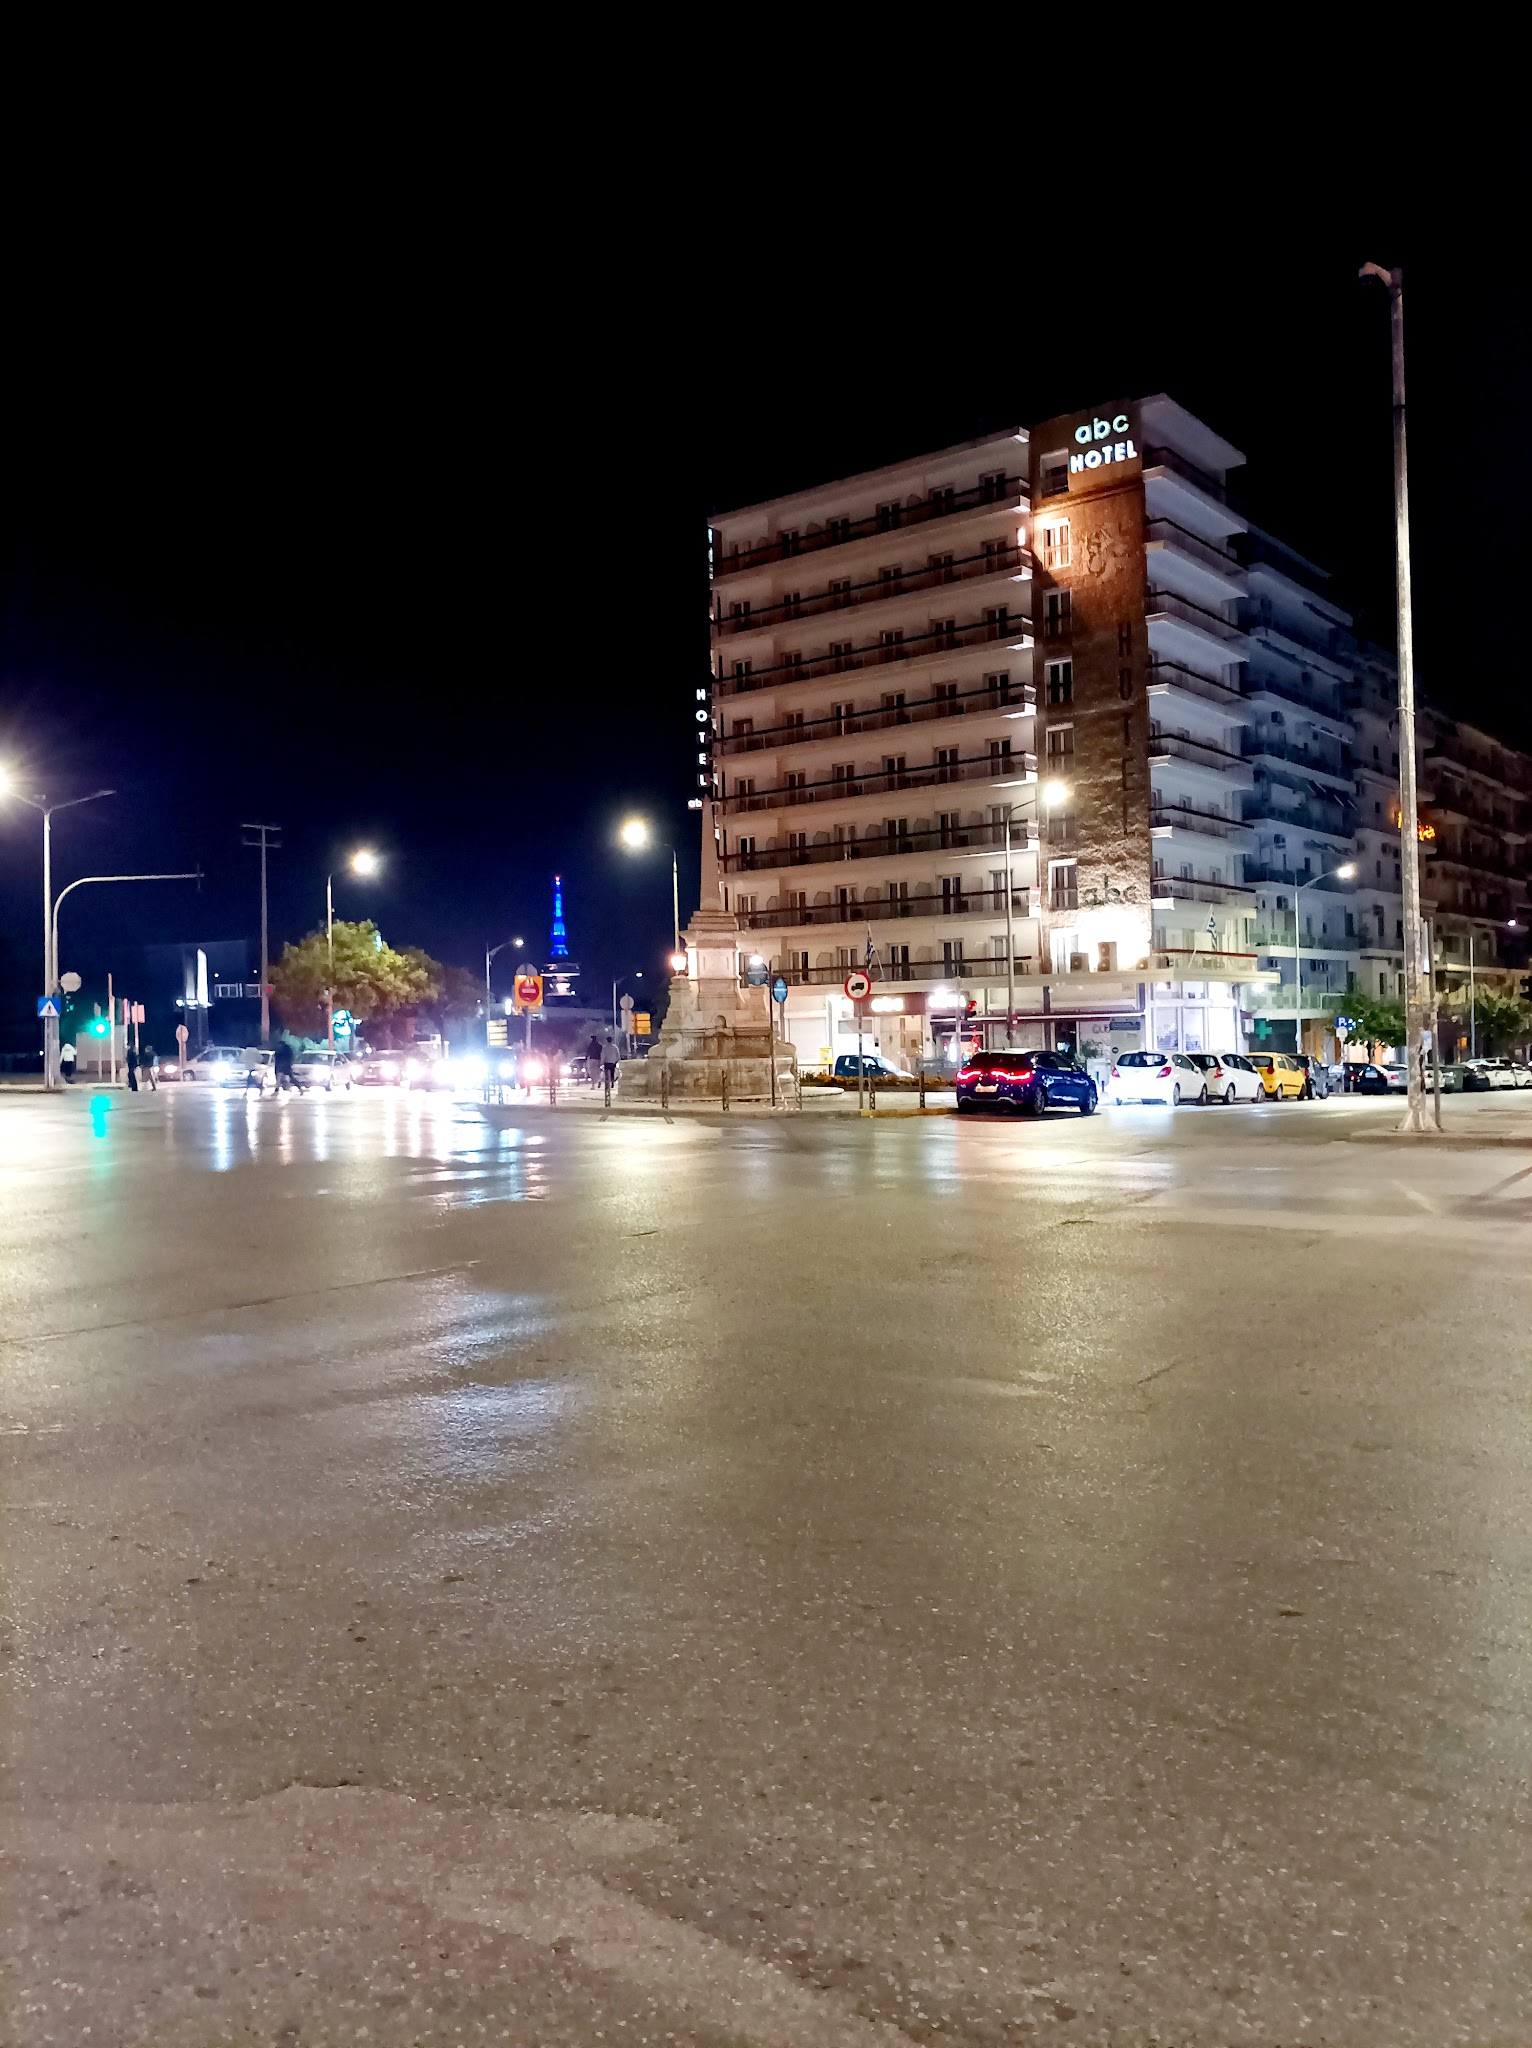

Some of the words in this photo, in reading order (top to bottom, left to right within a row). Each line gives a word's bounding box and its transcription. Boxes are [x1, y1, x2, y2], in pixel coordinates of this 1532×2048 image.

[1075, 415, 1129, 444] abc
[1070, 440, 1138, 474] HOTEL
[696, 689, 708, 787] HOTEL
[688, 798, 703, 809] ab
